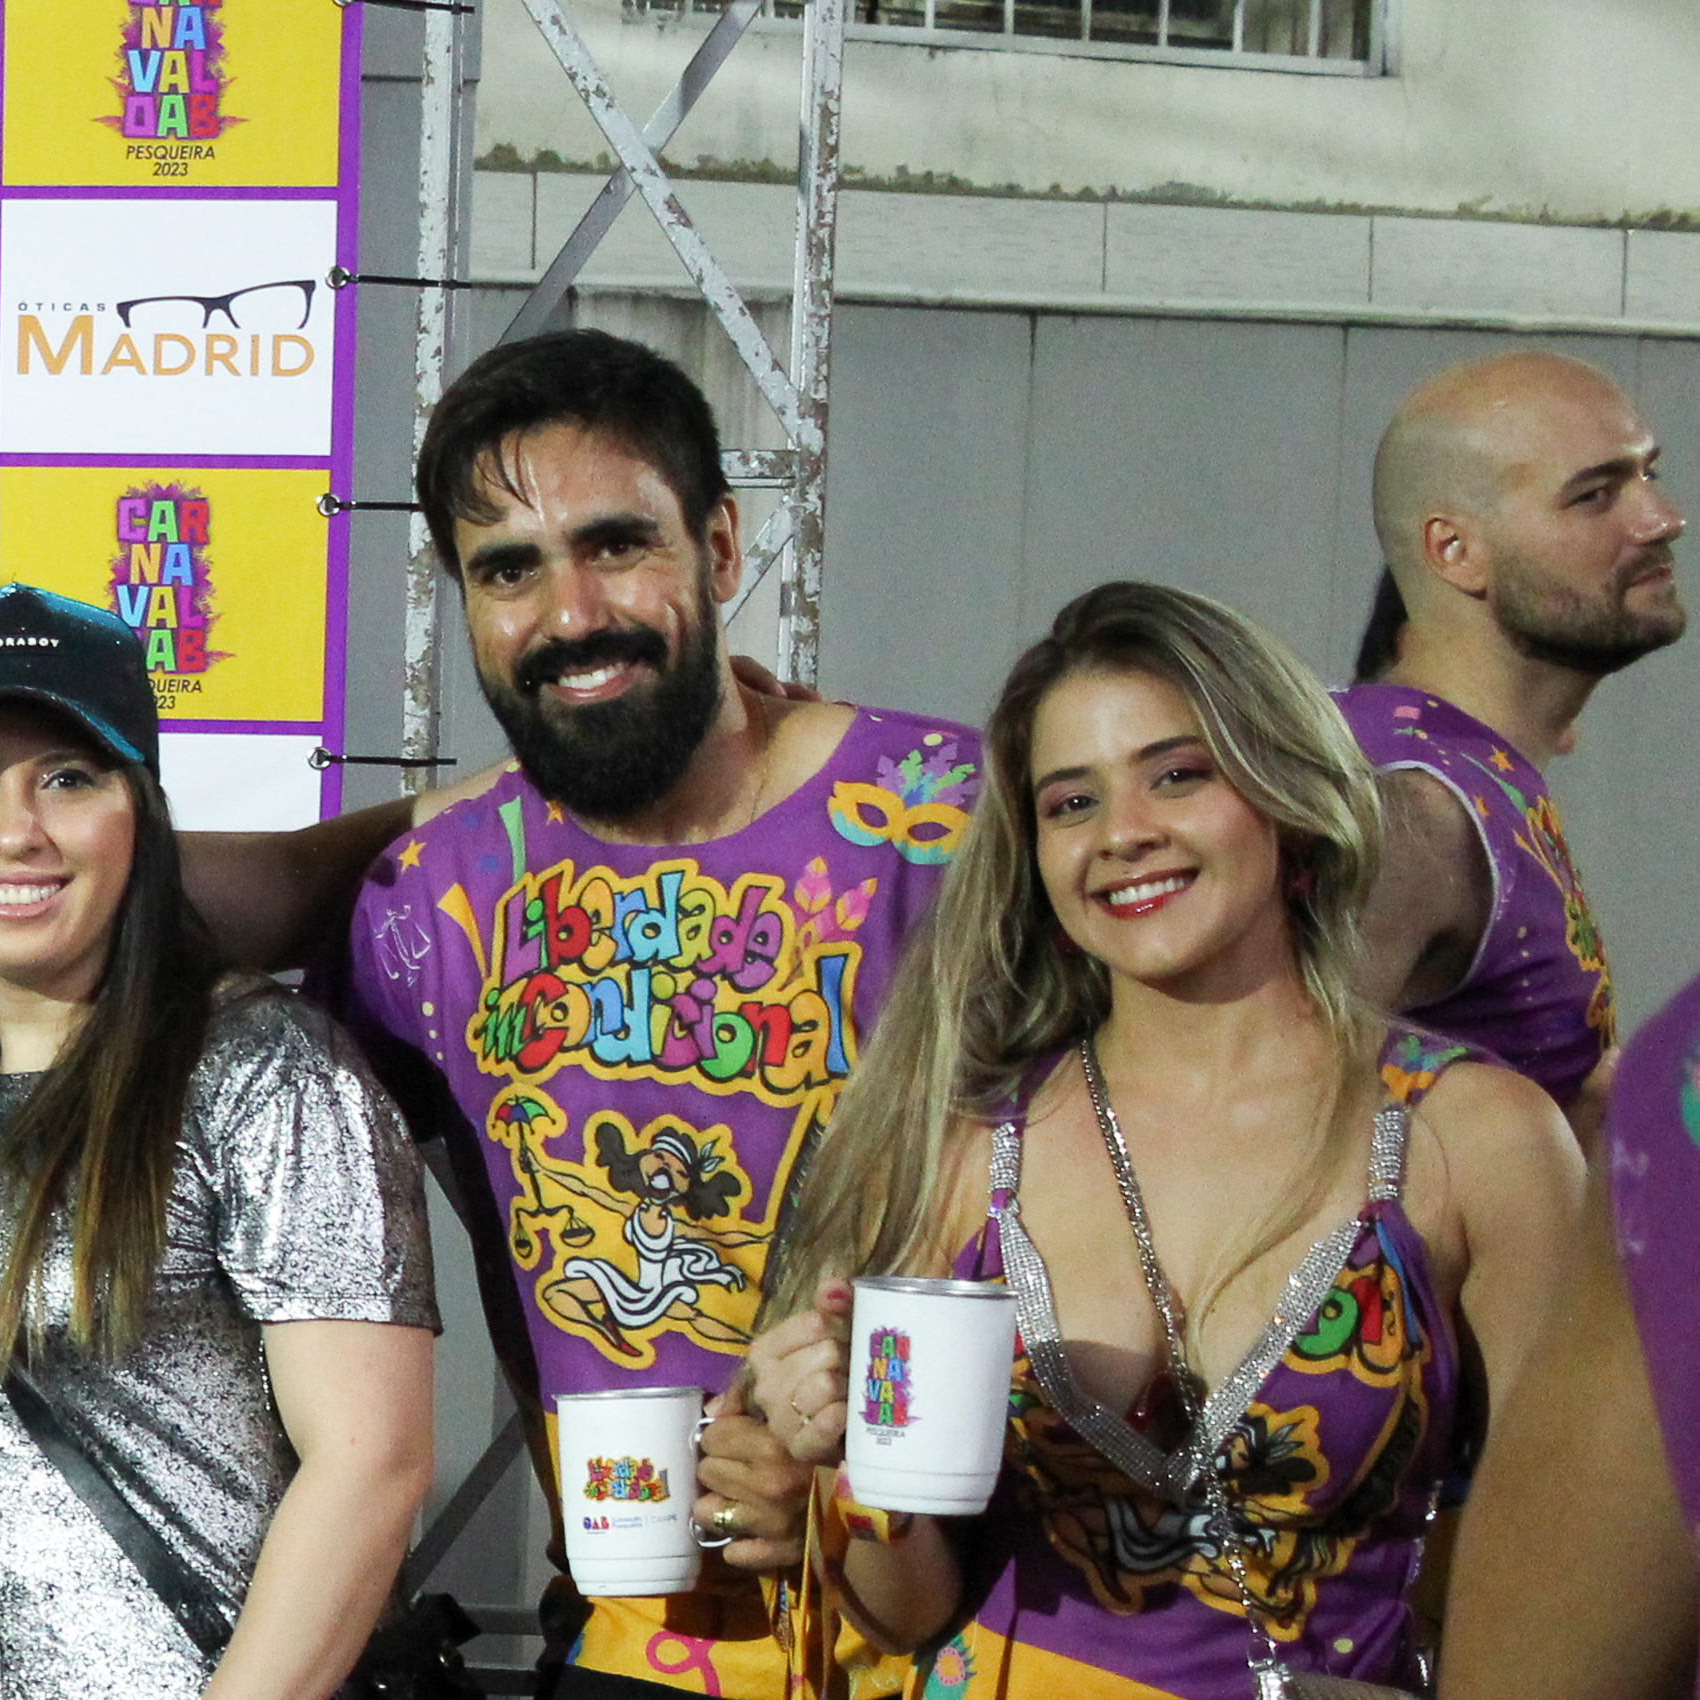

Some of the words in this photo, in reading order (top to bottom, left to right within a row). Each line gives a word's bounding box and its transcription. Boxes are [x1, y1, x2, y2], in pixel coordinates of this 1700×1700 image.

[141, 6, 206, 50] NA
[127, 49, 218, 93] VAL
[123, 94, 219, 139] OAB
[125, 145, 216, 160] PESQUEIRA
[152, 162, 188, 176] 2023
[18, 301, 106, 312] ÓTICAS
[117, 497, 210, 543] CAR
[130, 543, 194, 586] NA
[116, 584, 206, 628] VAL
[146, 628, 207, 674] AB
[148, 679, 203, 694] QUEIRA
[157, 695, 176, 709] 23
[500, 870, 784, 993] Liberdade
